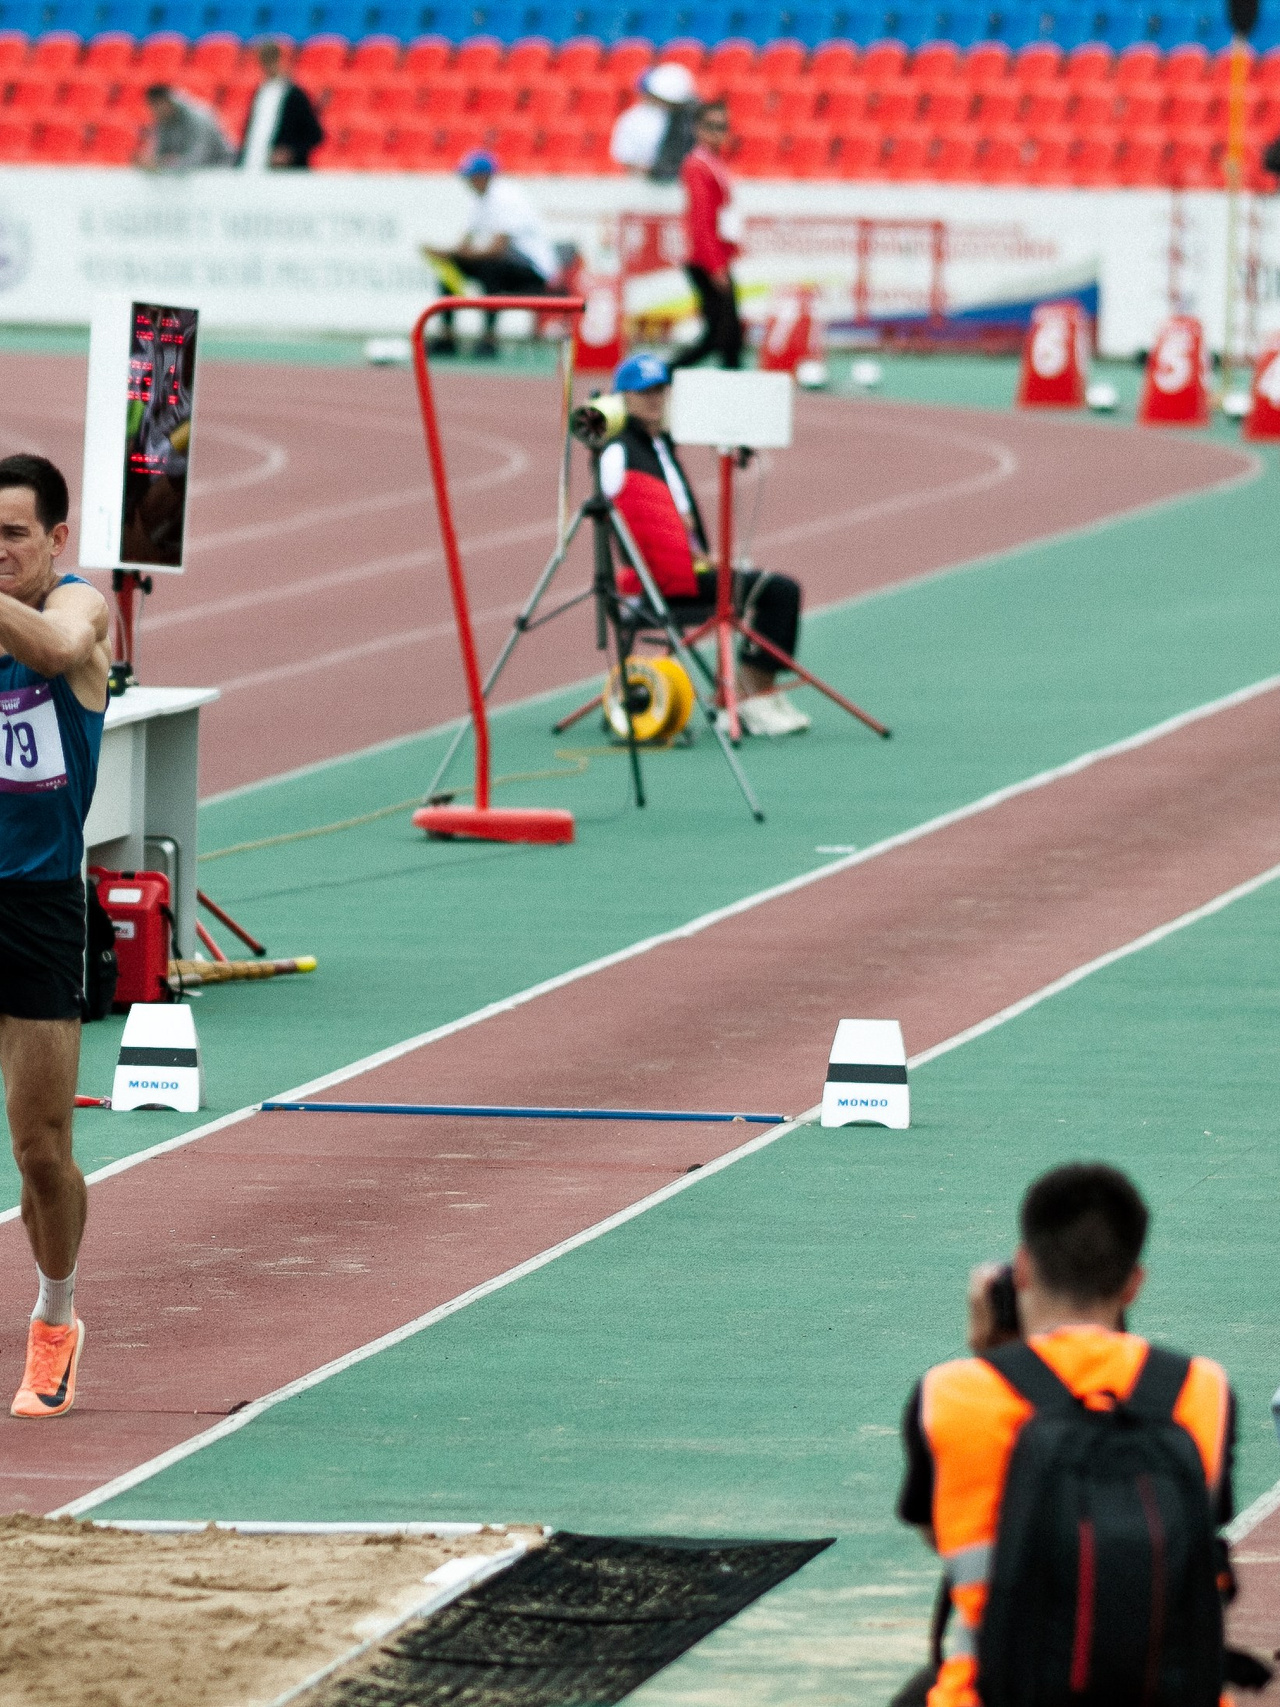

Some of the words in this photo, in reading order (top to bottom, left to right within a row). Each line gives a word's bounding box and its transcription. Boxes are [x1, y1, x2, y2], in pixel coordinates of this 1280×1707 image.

[768, 299, 801, 354] 7
[1032, 314, 1068, 379] 6
[1153, 329, 1191, 393] 5
[128, 1080, 179, 1090] MONDO
[837, 1098, 888, 1107] MONDO
